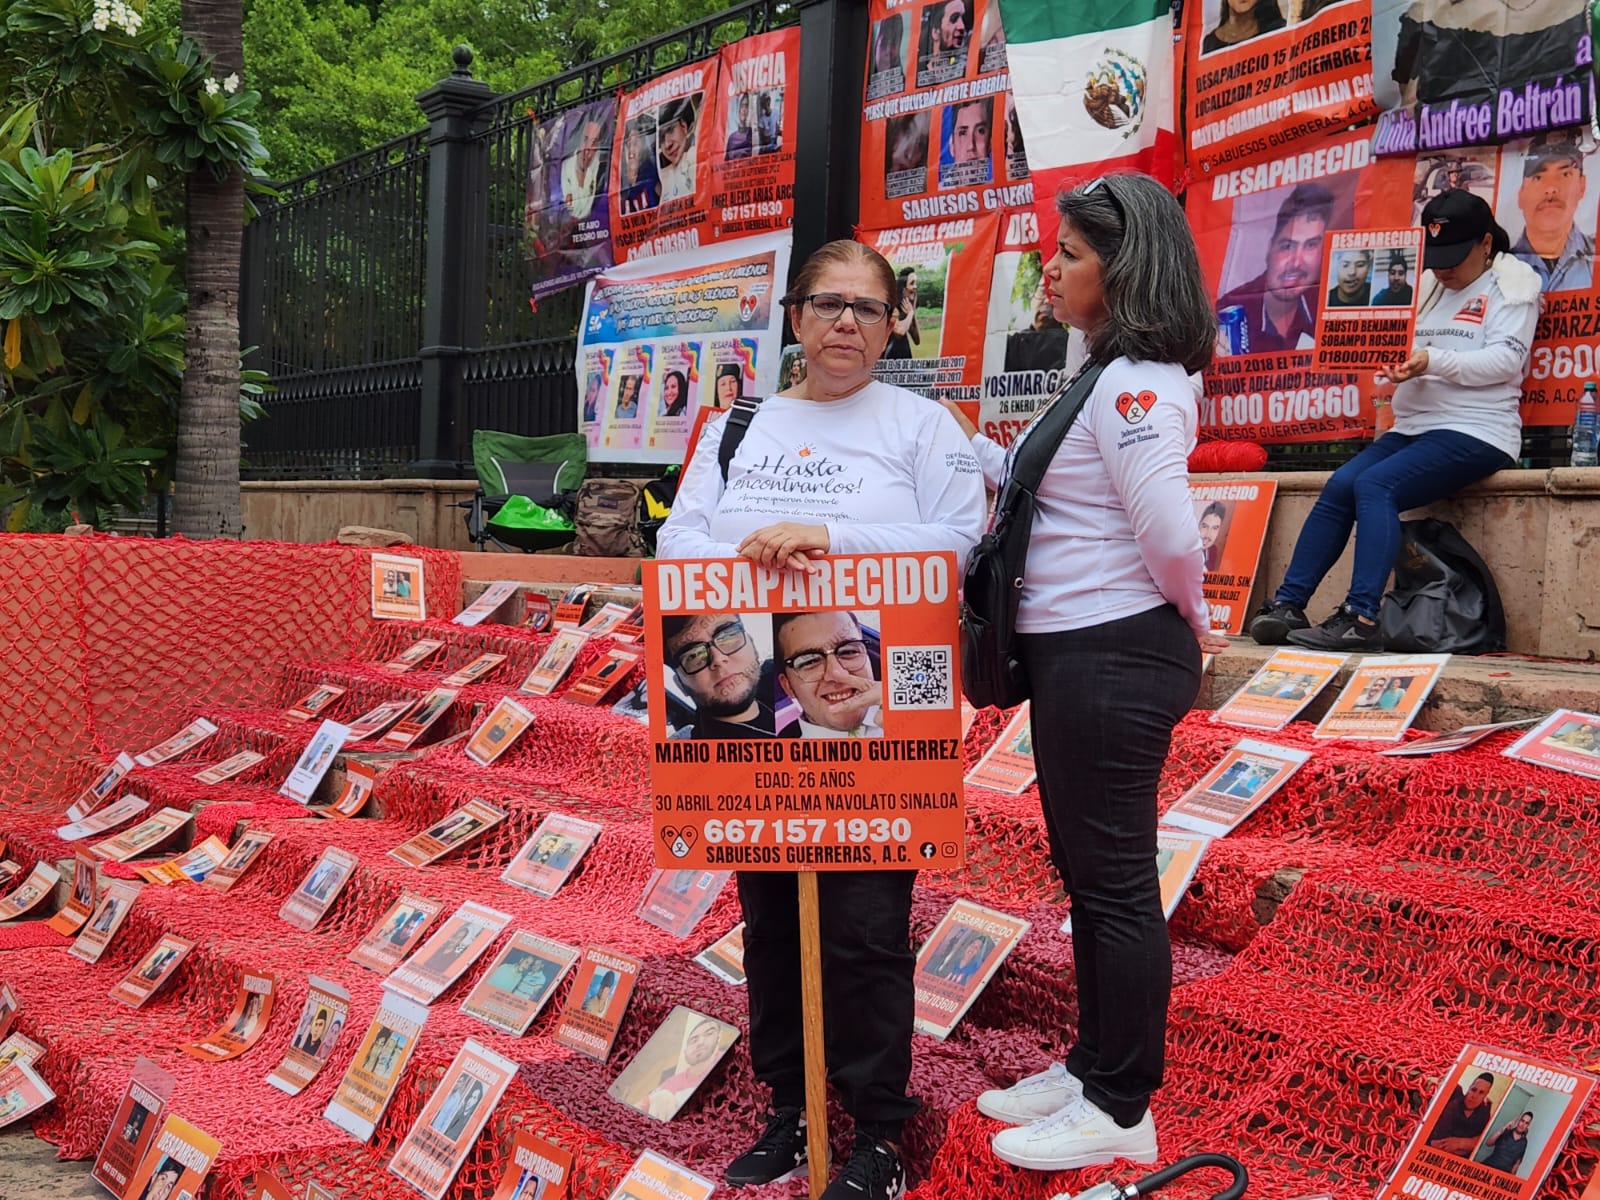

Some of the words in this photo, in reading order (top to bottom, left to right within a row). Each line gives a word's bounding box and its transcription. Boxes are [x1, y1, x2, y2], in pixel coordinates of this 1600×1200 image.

[1196, 52, 1269, 94] DESAPARECIO
[1272, 49, 1286, 67] 15
[1300, 20, 1358, 54] FEBRERO
[727, 51, 786, 96] JUSTICIA
[1195, 82, 1252, 119] LOCALIZADA
[1255, 77, 1271, 97] 29
[1288, 47, 1362, 83] DICIEMBRE
[1226, 98, 1292, 137] GUADALUPE
[1292, 79, 1352, 114] MILLAN
[1418, 98, 1491, 148] Andree
[1496, 74, 1582, 137] Beltrán
[1211, 135, 1268, 167] SABUESOS
[1212, 138, 1377, 201] DESAPARECID
[753, 186, 774, 203] ARIAS
[902, 191, 980, 221] SABUESOS
[875, 223, 936, 248] JUSTICIA
[937, 217, 975, 240] PARA
[1331, 229, 1421, 249] DESAPARECIDO
[1324, 320, 1359, 333] FAUSTO
[1361, 319, 1408, 332] BENJAMIN
[1435, 327, 1475, 340] GUERRERAS
[1321, 334, 1366, 347] SOBAMPO
[1368, 334, 1408, 347] ROSADO
[1244, 357, 1274, 373] 2018
[1276, 355, 1288, 366] EL
[984, 372, 1043, 399] YOSIMAR
[1249, 373, 1300, 393] ADELAIDO
[999, 400, 1009, 414] 26
[1010, 399, 1035, 413] ENERO
[1220, 393, 1263, 426] 800
[1268, 385, 1360, 423] 670360
[1200, 426, 1257, 443] SABUESOS
[747, 454, 848, 478] Hasta
[732, 477, 864, 495] encontrarlos!
[656, 554, 949, 612] DESAPARECIDO
[655, 742, 710, 763] MARIO
[716, 741, 784, 763] ARISTEO
[790, 740, 862, 762] GALINDO
[869, 739, 960, 761] GUTIERREZ
[755, 771, 794, 789] EDAD:
[798, 771, 816, 788] 26
[819, 767, 856, 788] AÑOS
[655, 794, 672, 811] 30
[676, 794, 714, 811] ABRIL
[717, 794, 752, 811] 2024
[755, 793, 773, 811] LA
[775, 793, 822, 811] PALMA
[825, 792, 897, 811] NAVOLATO
[900, 792, 959, 810] SINALOA
[703, 818, 765, 844] 667
[771, 818, 827, 843] 157
[833, 817, 912, 843] 1930
[706, 845, 781, 864] SABUESOS
[786, 845, 878, 865] GUERRERAS,
[882, 845, 912, 863] A.C.
[586, 950, 636, 975] DESAPARECIDO
[1471, 1050, 1578, 1094] DESAPARECIDO
[514, 1145, 565, 1186] DESAPARECIDO
[1407, 1162, 1437, 1180] RAFAEL
[1401, 1175, 1420, 1196] 01
